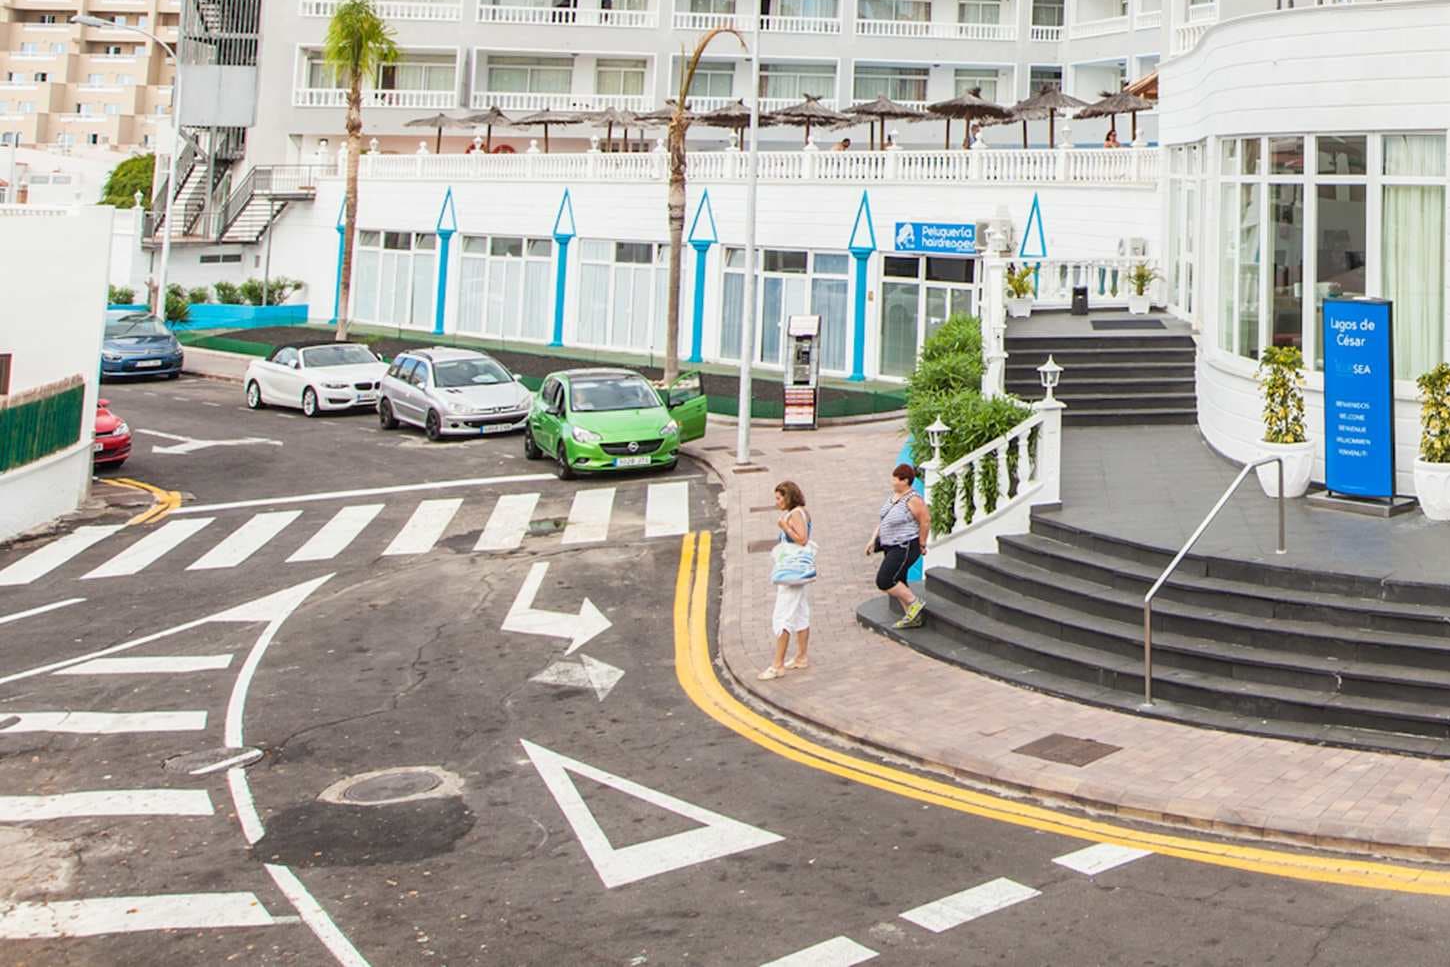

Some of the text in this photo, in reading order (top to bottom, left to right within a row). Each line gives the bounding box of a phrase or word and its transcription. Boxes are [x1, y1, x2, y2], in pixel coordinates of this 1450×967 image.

[1330, 316, 1376, 332] Lagos de
[1336, 333, 1366, 346] César
